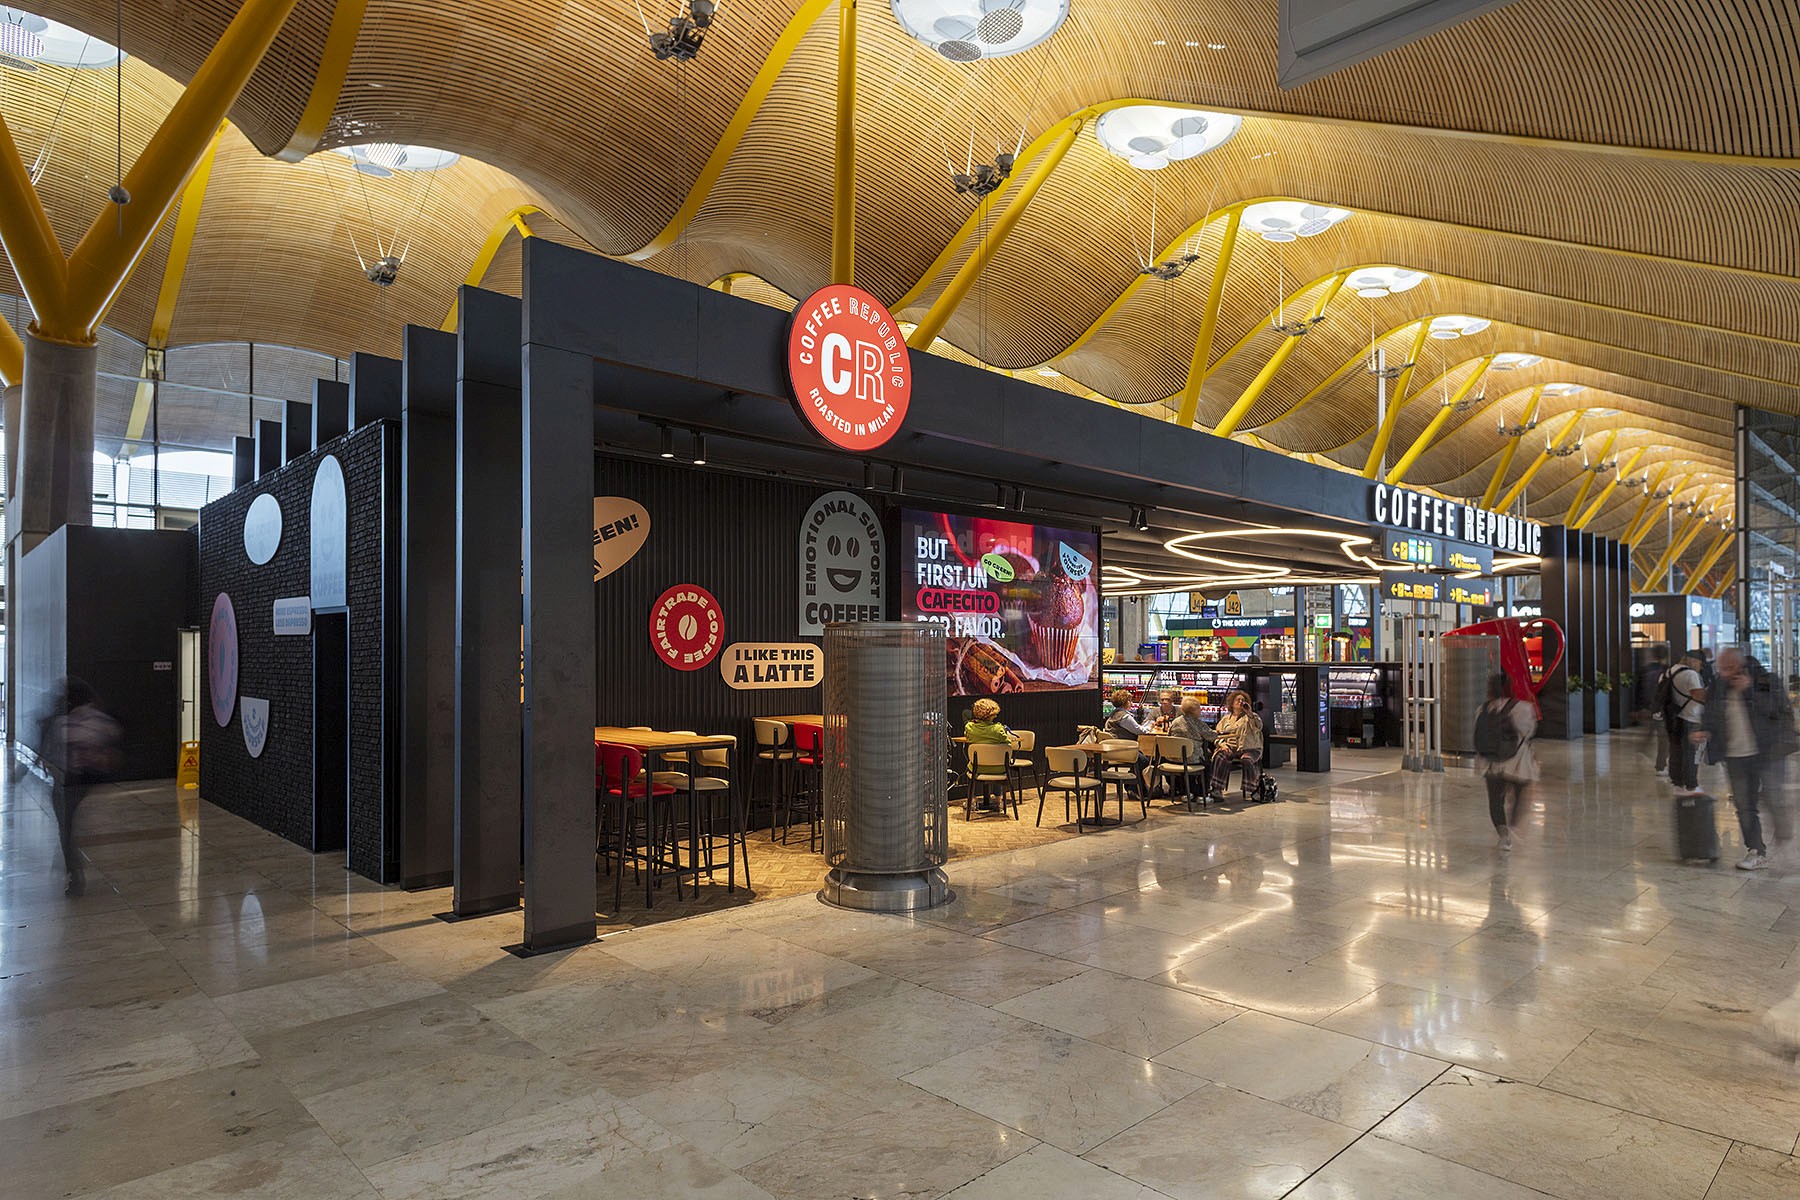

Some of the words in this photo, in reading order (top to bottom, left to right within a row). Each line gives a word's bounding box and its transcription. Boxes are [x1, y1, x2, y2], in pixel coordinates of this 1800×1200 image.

[800, 297, 842, 365] COFFEE
[849, 297, 904, 388] REPUBLIC
[820, 332, 886, 404] CR
[809, 387, 852, 434] ROASTED
[854, 423, 866, 436] IN
[868, 403, 896, 434] MILAN
[1374, 483, 1456, 537] COFFEE
[1464, 505, 1542, 555] REPUBLIC
[805, 500, 857, 596] EMOTIONAL
[858, 511, 881, 599] SUPORT
[917, 536, 949, 560] BUT
[917, 562, 967, 591] FIRST,
[968, 566, 988, 589] UN
[984, 558, 992, 566] GO
[992, 563, 1012, 576] GREEN!
[921, 591, 996, 611] CAFECITO
[1227, 602, 1239, 612] J42
[806, 602, 880, 624] COFFEE
[1250, 618, 1268, 626] SHOP
[655, 591, 709, 660] FAIRTRADE
[684, 608, 718, 664] COFFEE
[955, 616, 1006, 639] FAVOR.
[736, 650, 740, 661] I
[744, 649, 778, 661] LIKE
[781, 649, 815, 661] THIS
[734, 664, 749, 684] A
[753, 664, 815, 683] LATTE
